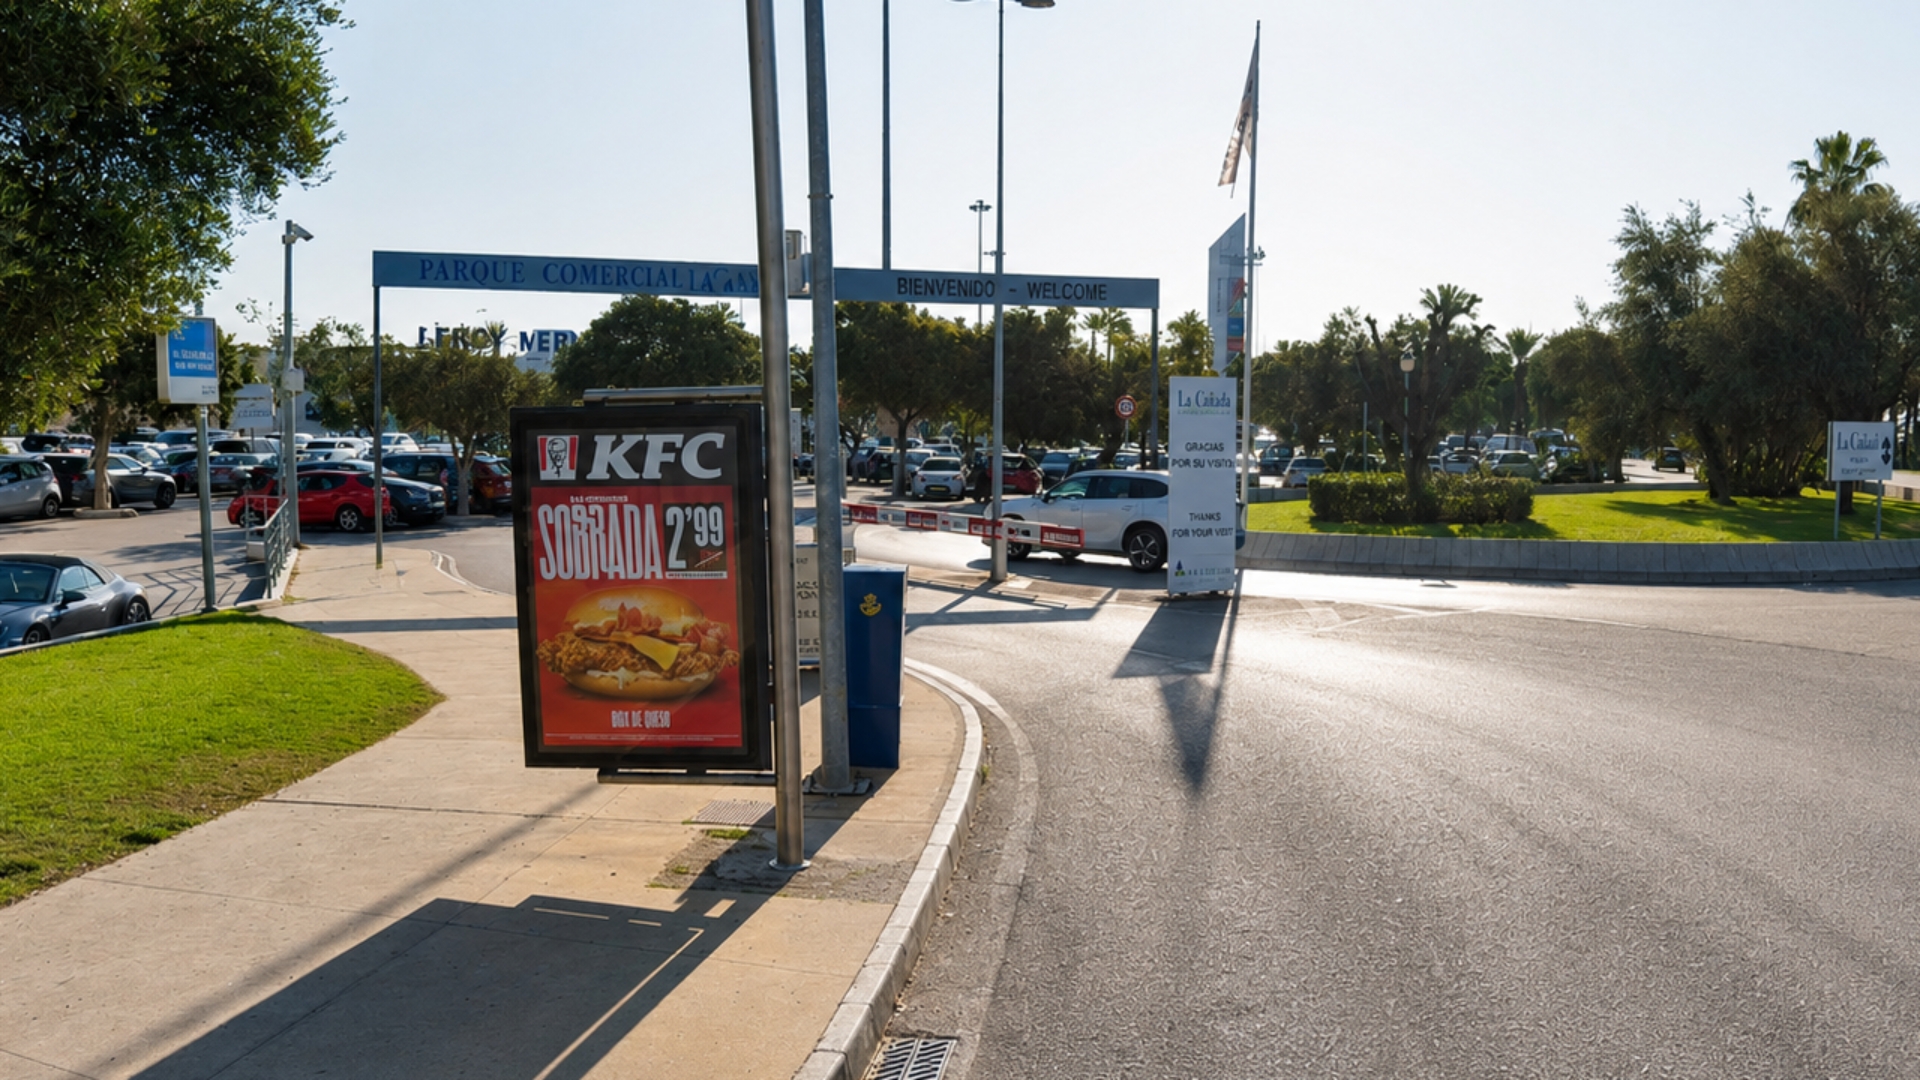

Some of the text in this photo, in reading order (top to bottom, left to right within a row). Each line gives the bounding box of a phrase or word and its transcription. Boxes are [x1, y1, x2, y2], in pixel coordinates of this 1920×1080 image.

[419, 258, 525, 285] PARQUE
[542, 262, 684, 289] COMERCIAL
[896, 277, 996, 299] BIENVENIDO
[1026, 281, 1108, 302] WELCOME
[1184, 441, 1225, 453] GRACIAS
[586, 432, 726, 481] KFC
[1171, 458, 1192, 469] POR
[1192, 458, 1206, 469] SU
[1188, 512, 1222, 522] THANKS
[1172, 528, 1190, 539] FOR
[1190, 528, 1213, 538] YOUR
